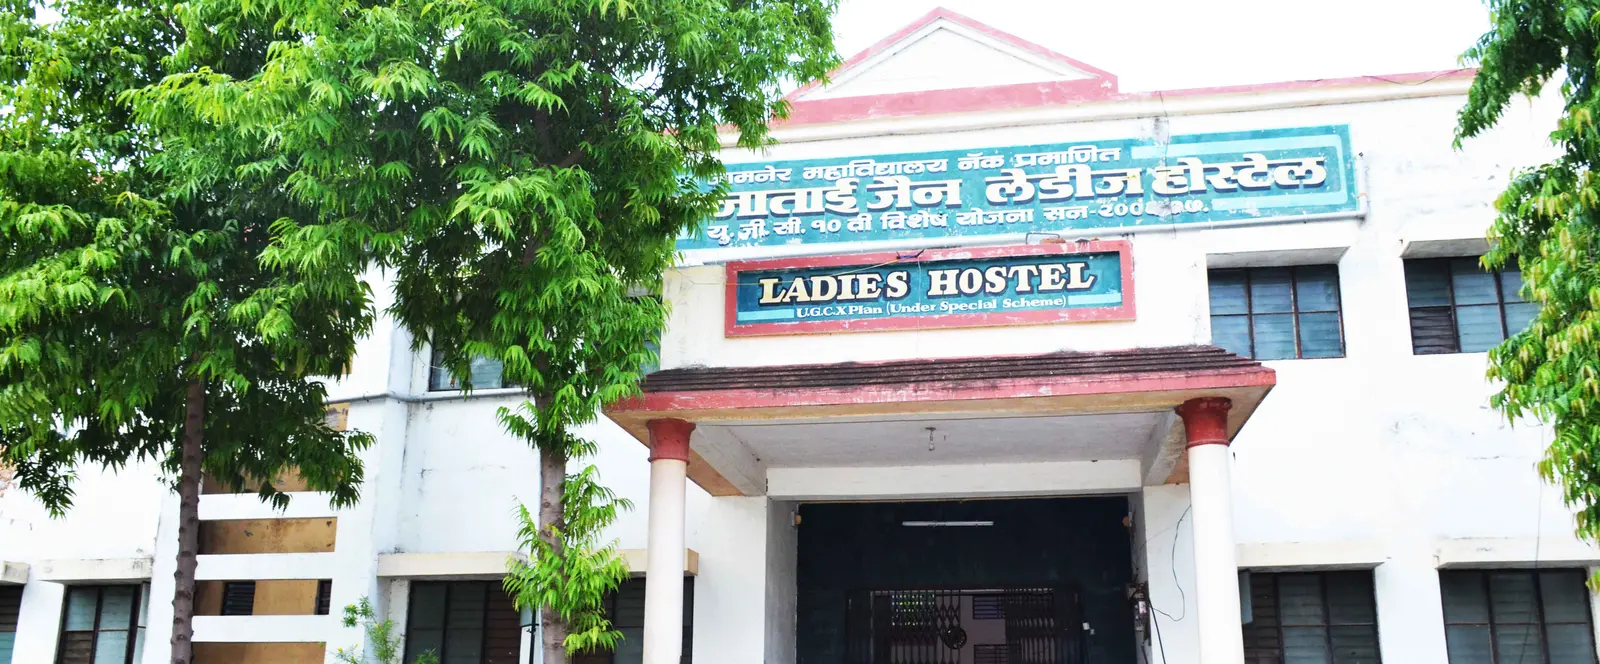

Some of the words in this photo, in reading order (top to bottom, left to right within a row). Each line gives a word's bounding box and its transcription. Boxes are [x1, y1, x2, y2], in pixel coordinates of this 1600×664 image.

[802, 158, 948, 181] महाविद्यालय
[1014, 145, 1121, 168] प्रमाणित
[984, 163, 1144, 206] लेडीज
[1152, 153, 1327, 197] होस्टेल
[956, 207, 1035, 227] योजना
[759, 270, 910, 305] LADIES
[927, 262, 1096, 297] HOSTEL
[886, 301, 936, 316] (Under
[939, 299, 997, 314] Special
[1002, 295, 1067, 310] Scheme)
